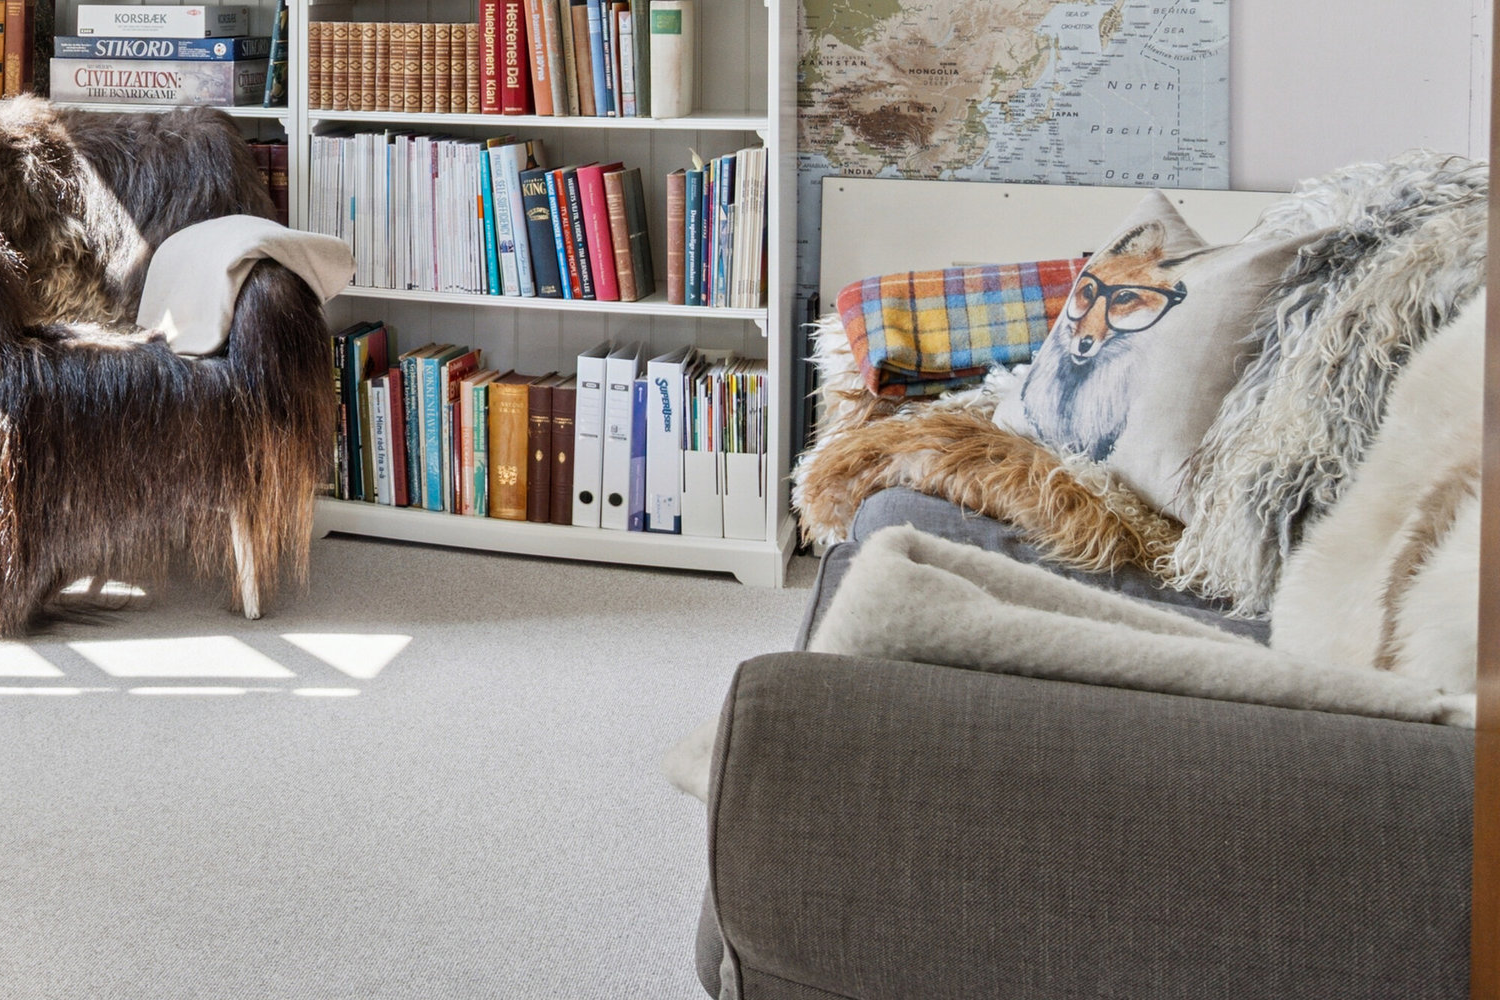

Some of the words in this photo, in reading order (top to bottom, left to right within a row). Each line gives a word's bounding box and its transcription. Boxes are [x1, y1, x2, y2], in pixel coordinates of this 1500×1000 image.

[114, 13, 167, 24] KORSBÆK
[484, 3, 495, 75] Hulebjørnens
[505, 3, 518, 66] Hestenes
[531, 14, 542, 49] Danmark
[95, 39, 174, 57] STIKORD
[74, 67, 182, 89] CIVILIZATION:
[506, 67, 520, 88] Dal
[908, 68, 959, 76] MONGOLIA
[86, 88, 107, 99] THE
[109, 88, 177, 100] BOARDGAME
[486, 79, 497, 104] Klan
[1107, 81, 1175, 90] North
[880, 105, 938, 113] CHINA
[1090, 125, 1180, 136] Pacific
[547, 174, 555, 195] MANGE
[1105, 170, 1175, 181] Ocean
[522, 182, 547, 197] KING
[688, 224, 697, 250] spiselige
[569, 254, 577, 277] PEOPLE
[574, 221, 582, 242] VERDEN
[580, 258, 591, 293] BERNERS-LEE
[688, 251, 696, 286] permahave
[425, 364, 436, 444] KØKKENHAVEN
[655, 377, 672, 433] SUPERUSERS
[376, 415, 384, 435] Mine
[377, 437, 385, 451] råd
